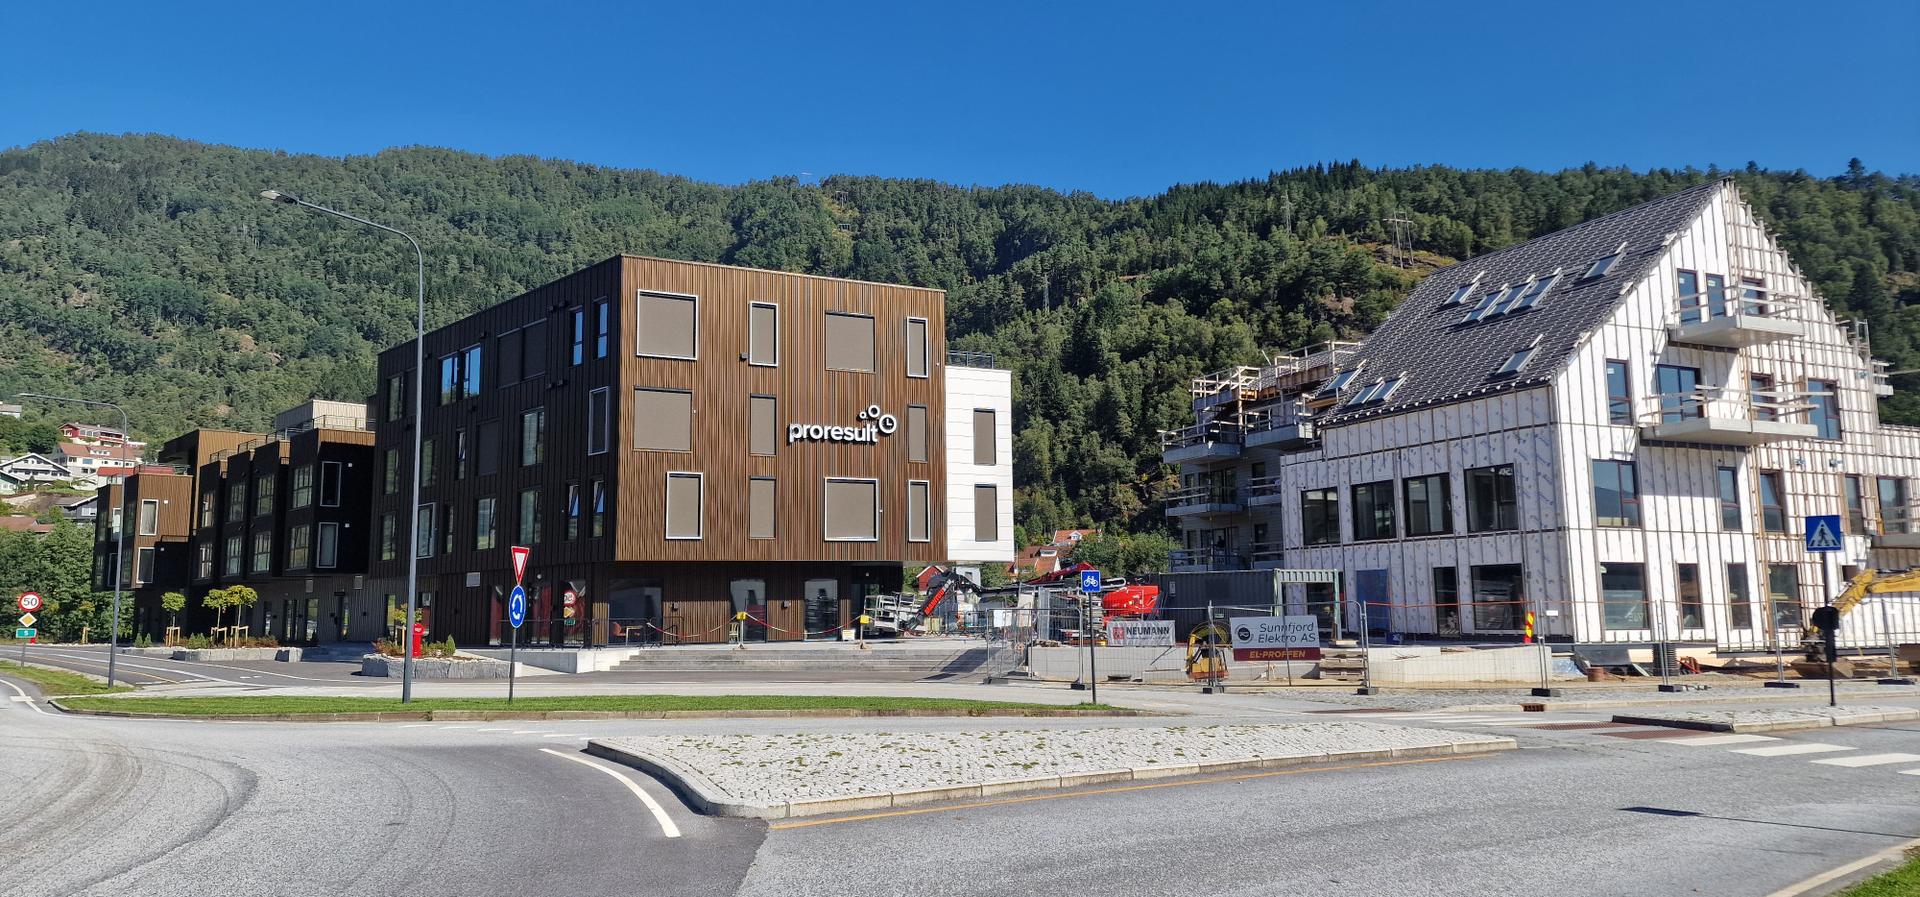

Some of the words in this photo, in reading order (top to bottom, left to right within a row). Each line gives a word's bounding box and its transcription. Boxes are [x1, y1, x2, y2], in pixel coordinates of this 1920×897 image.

[789, 423, 878, 443] proresult
[23, 597, 37, 606] 50
[1126, 626, 1170, 636] NEUMANN
[1259, 622, 1314, 634] Sunnfjord
[1258, 633, 1297, 643] Elektro
[1300, 633, 1316, 643] AS
